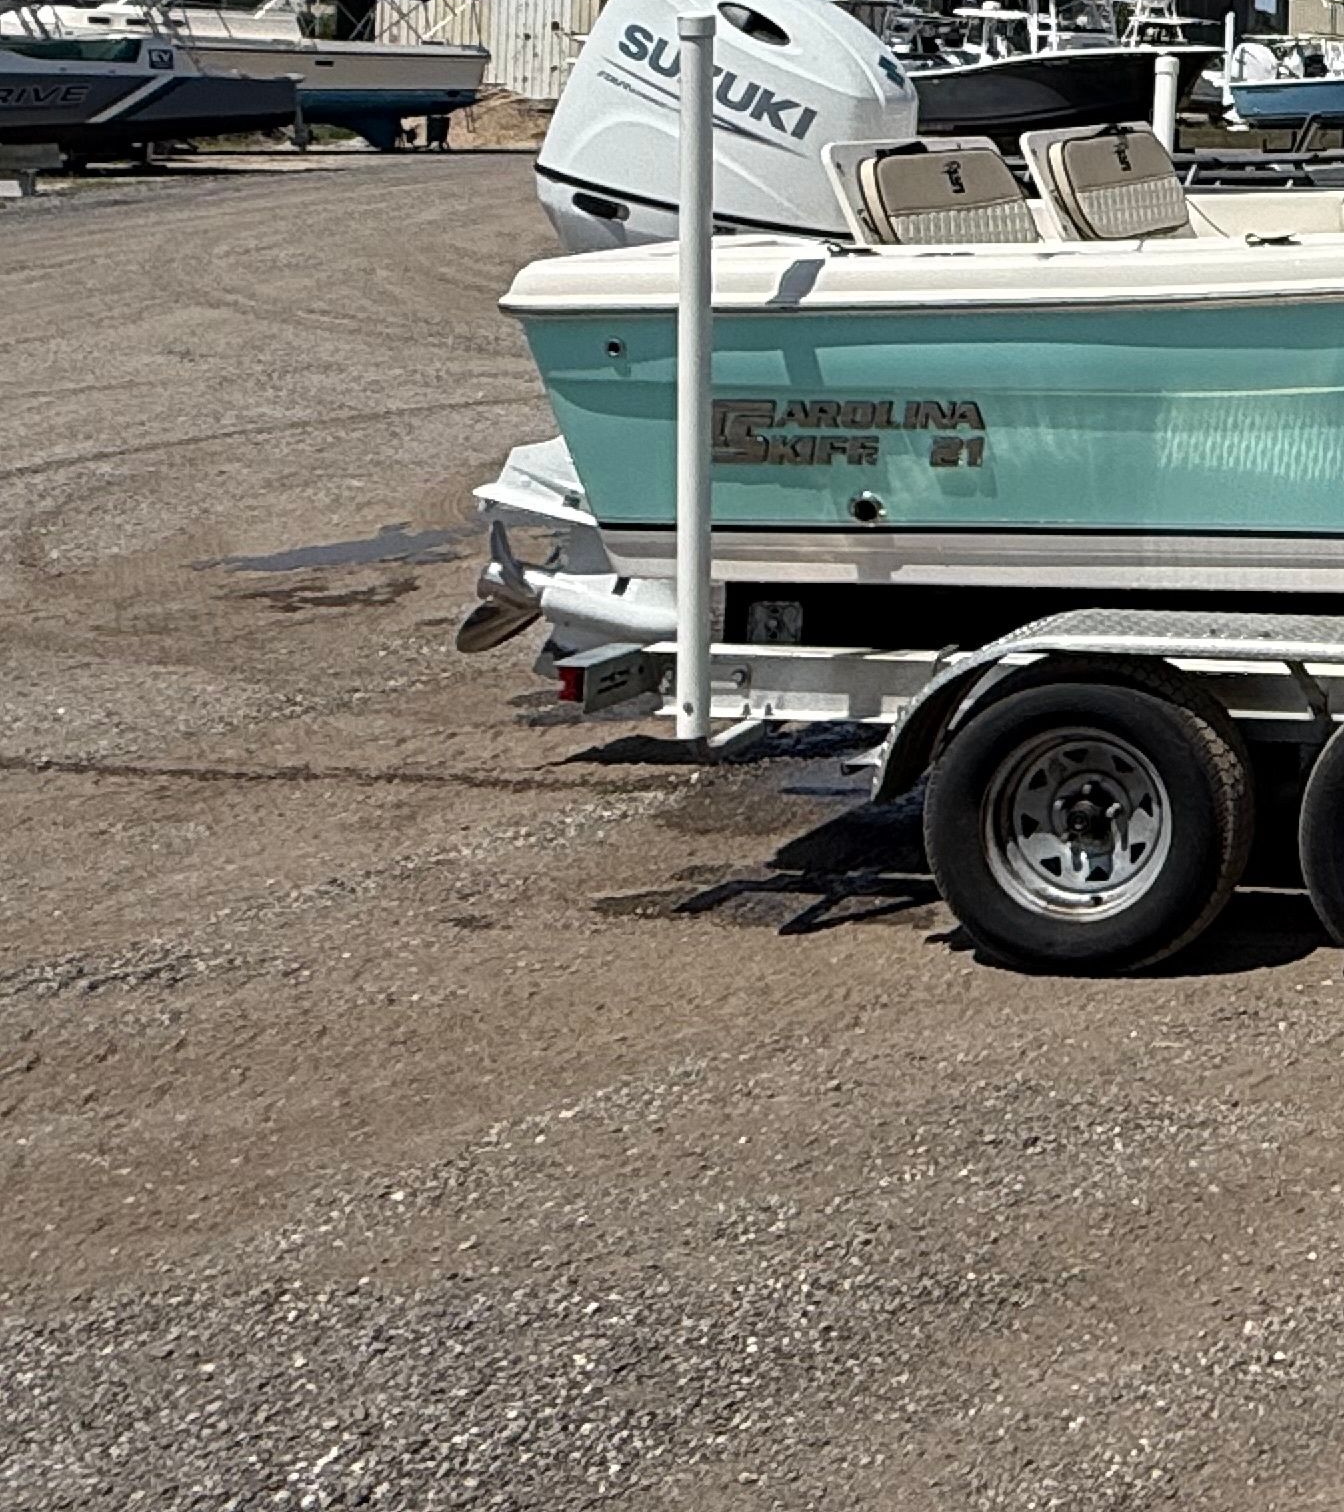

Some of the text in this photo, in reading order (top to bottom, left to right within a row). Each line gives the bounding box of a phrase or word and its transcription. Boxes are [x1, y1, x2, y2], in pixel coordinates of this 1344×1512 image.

[618, 23, 818, 140] SUUKI
[712, 398, 986, 444] CAROLINA
[929, 436, 984, 467] 21
